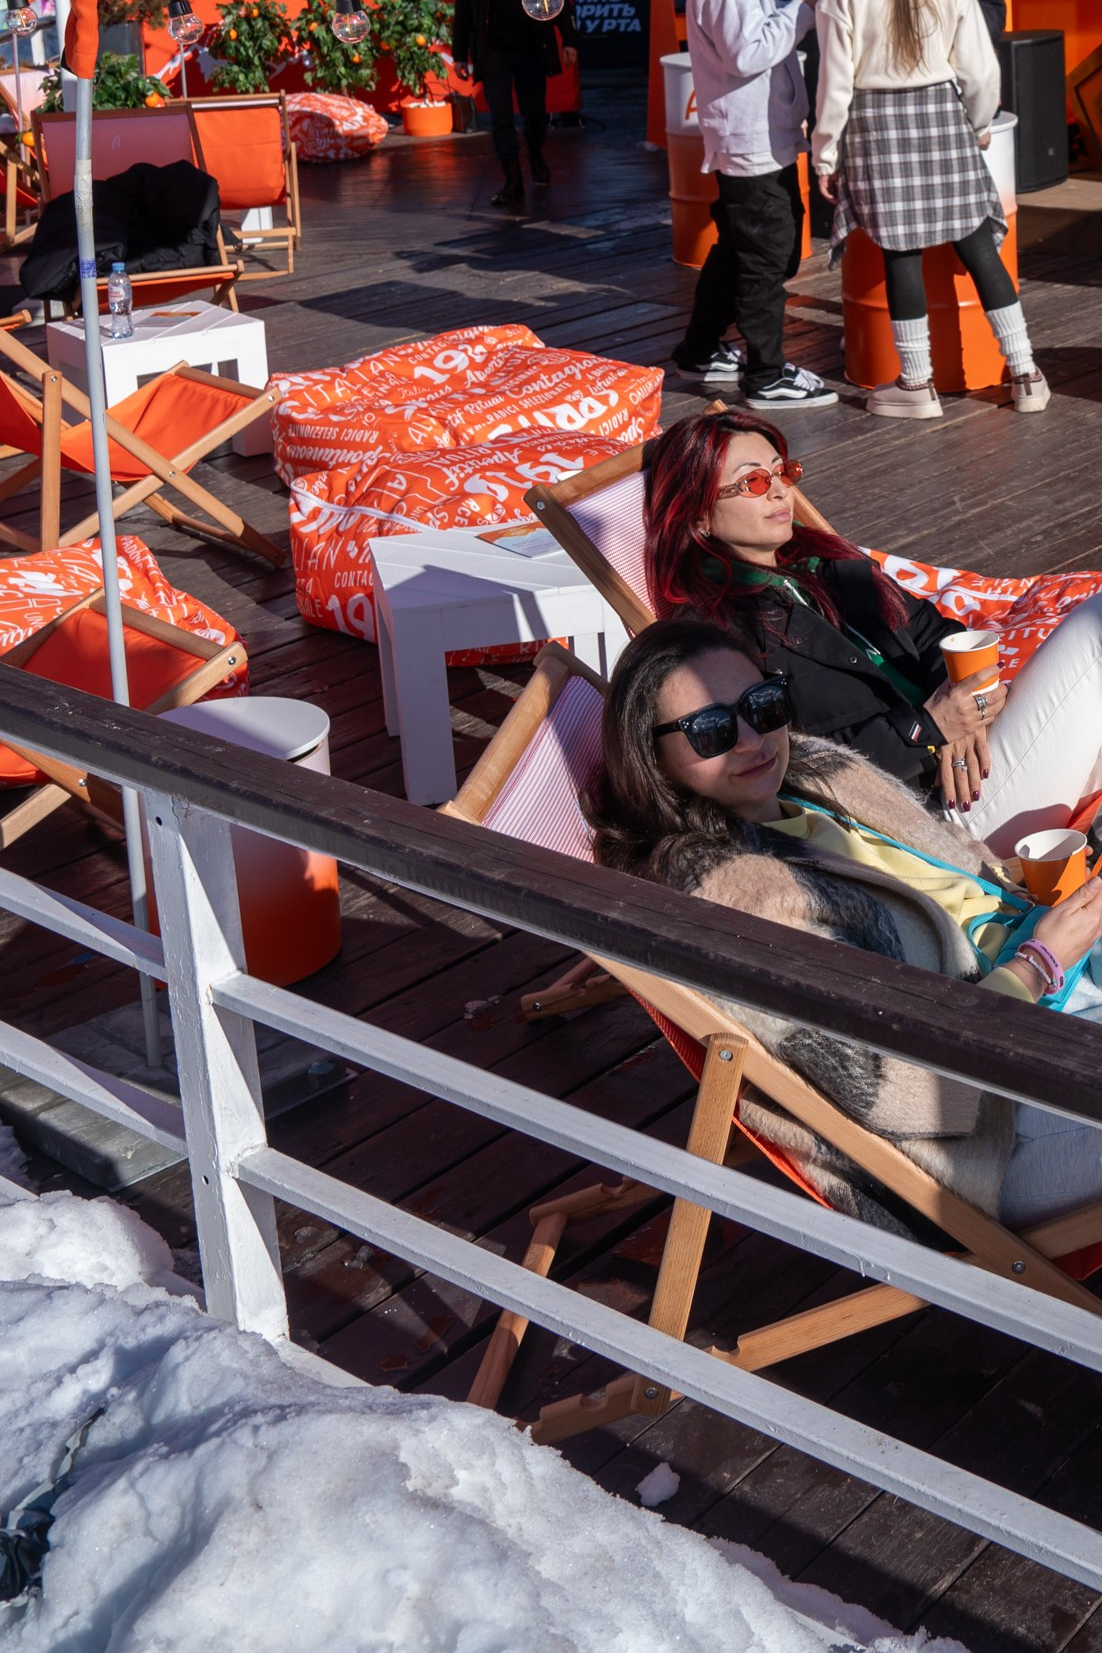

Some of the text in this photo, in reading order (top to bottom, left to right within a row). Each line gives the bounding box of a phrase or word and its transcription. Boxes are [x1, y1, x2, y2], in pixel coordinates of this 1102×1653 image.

[576, 3, 636, 18] РИТЬ
[288, 423, 379, 444] RADICI SELEZIONATE
